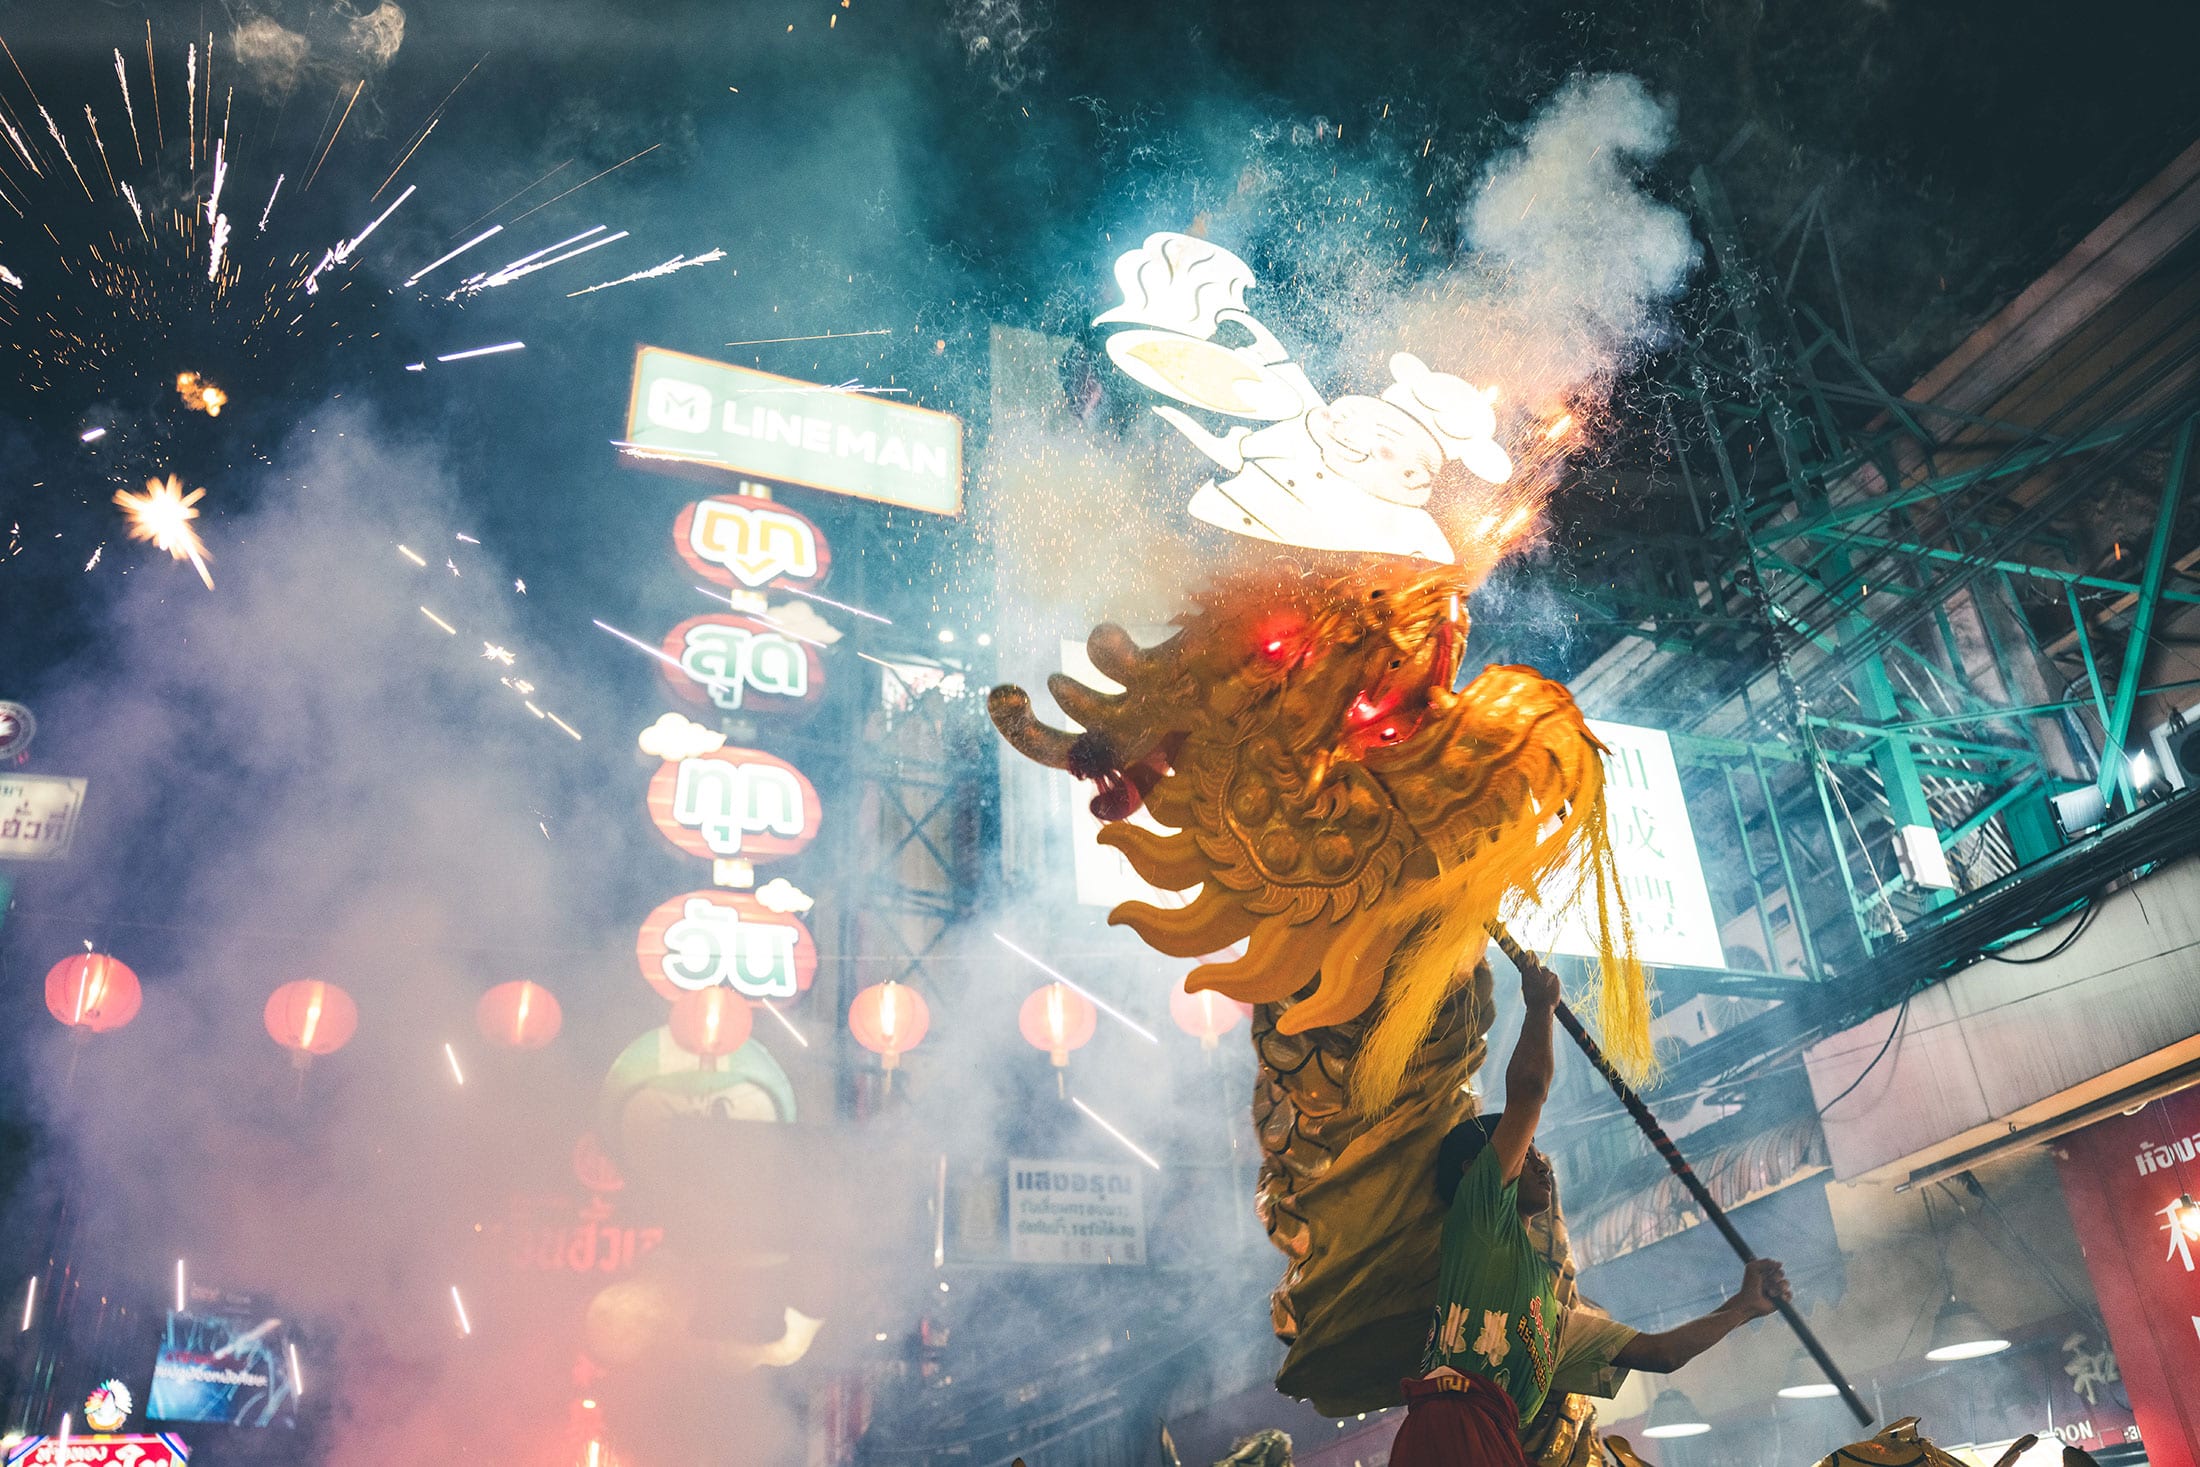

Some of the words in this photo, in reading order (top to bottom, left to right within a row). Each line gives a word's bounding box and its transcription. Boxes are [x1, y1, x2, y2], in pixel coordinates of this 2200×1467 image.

[721, 402, 832, 453] LINE
[836, 426, 948, 479] MAN
[689, 632, 801, 702] สุด
[683, 767, 793, 845] ทุก
[671, 906, 788, 988] วัน
